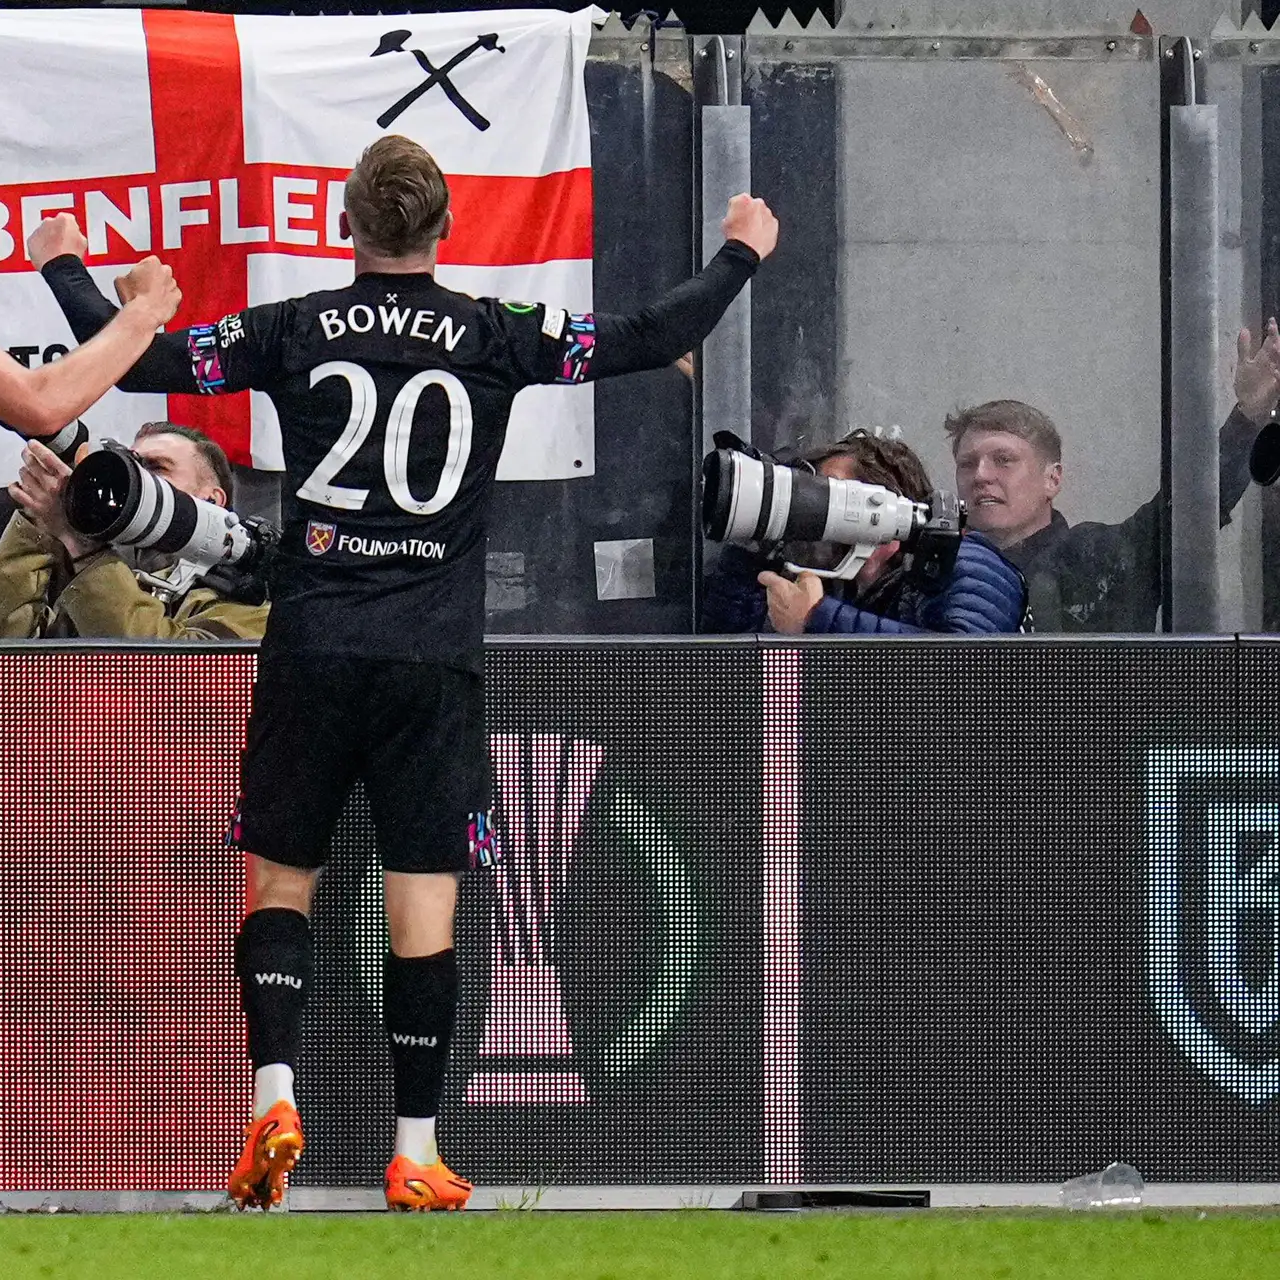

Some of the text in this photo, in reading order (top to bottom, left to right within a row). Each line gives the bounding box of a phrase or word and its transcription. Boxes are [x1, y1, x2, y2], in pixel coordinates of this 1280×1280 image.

[318, 304, 467, 352] BOWEN
[295, 360, 474, 516] 20
[338, 534, 446, 560] FOUNDATION
[255, 973, 302, 989] WHU
[393, 1032, 438, 1048] WHU
